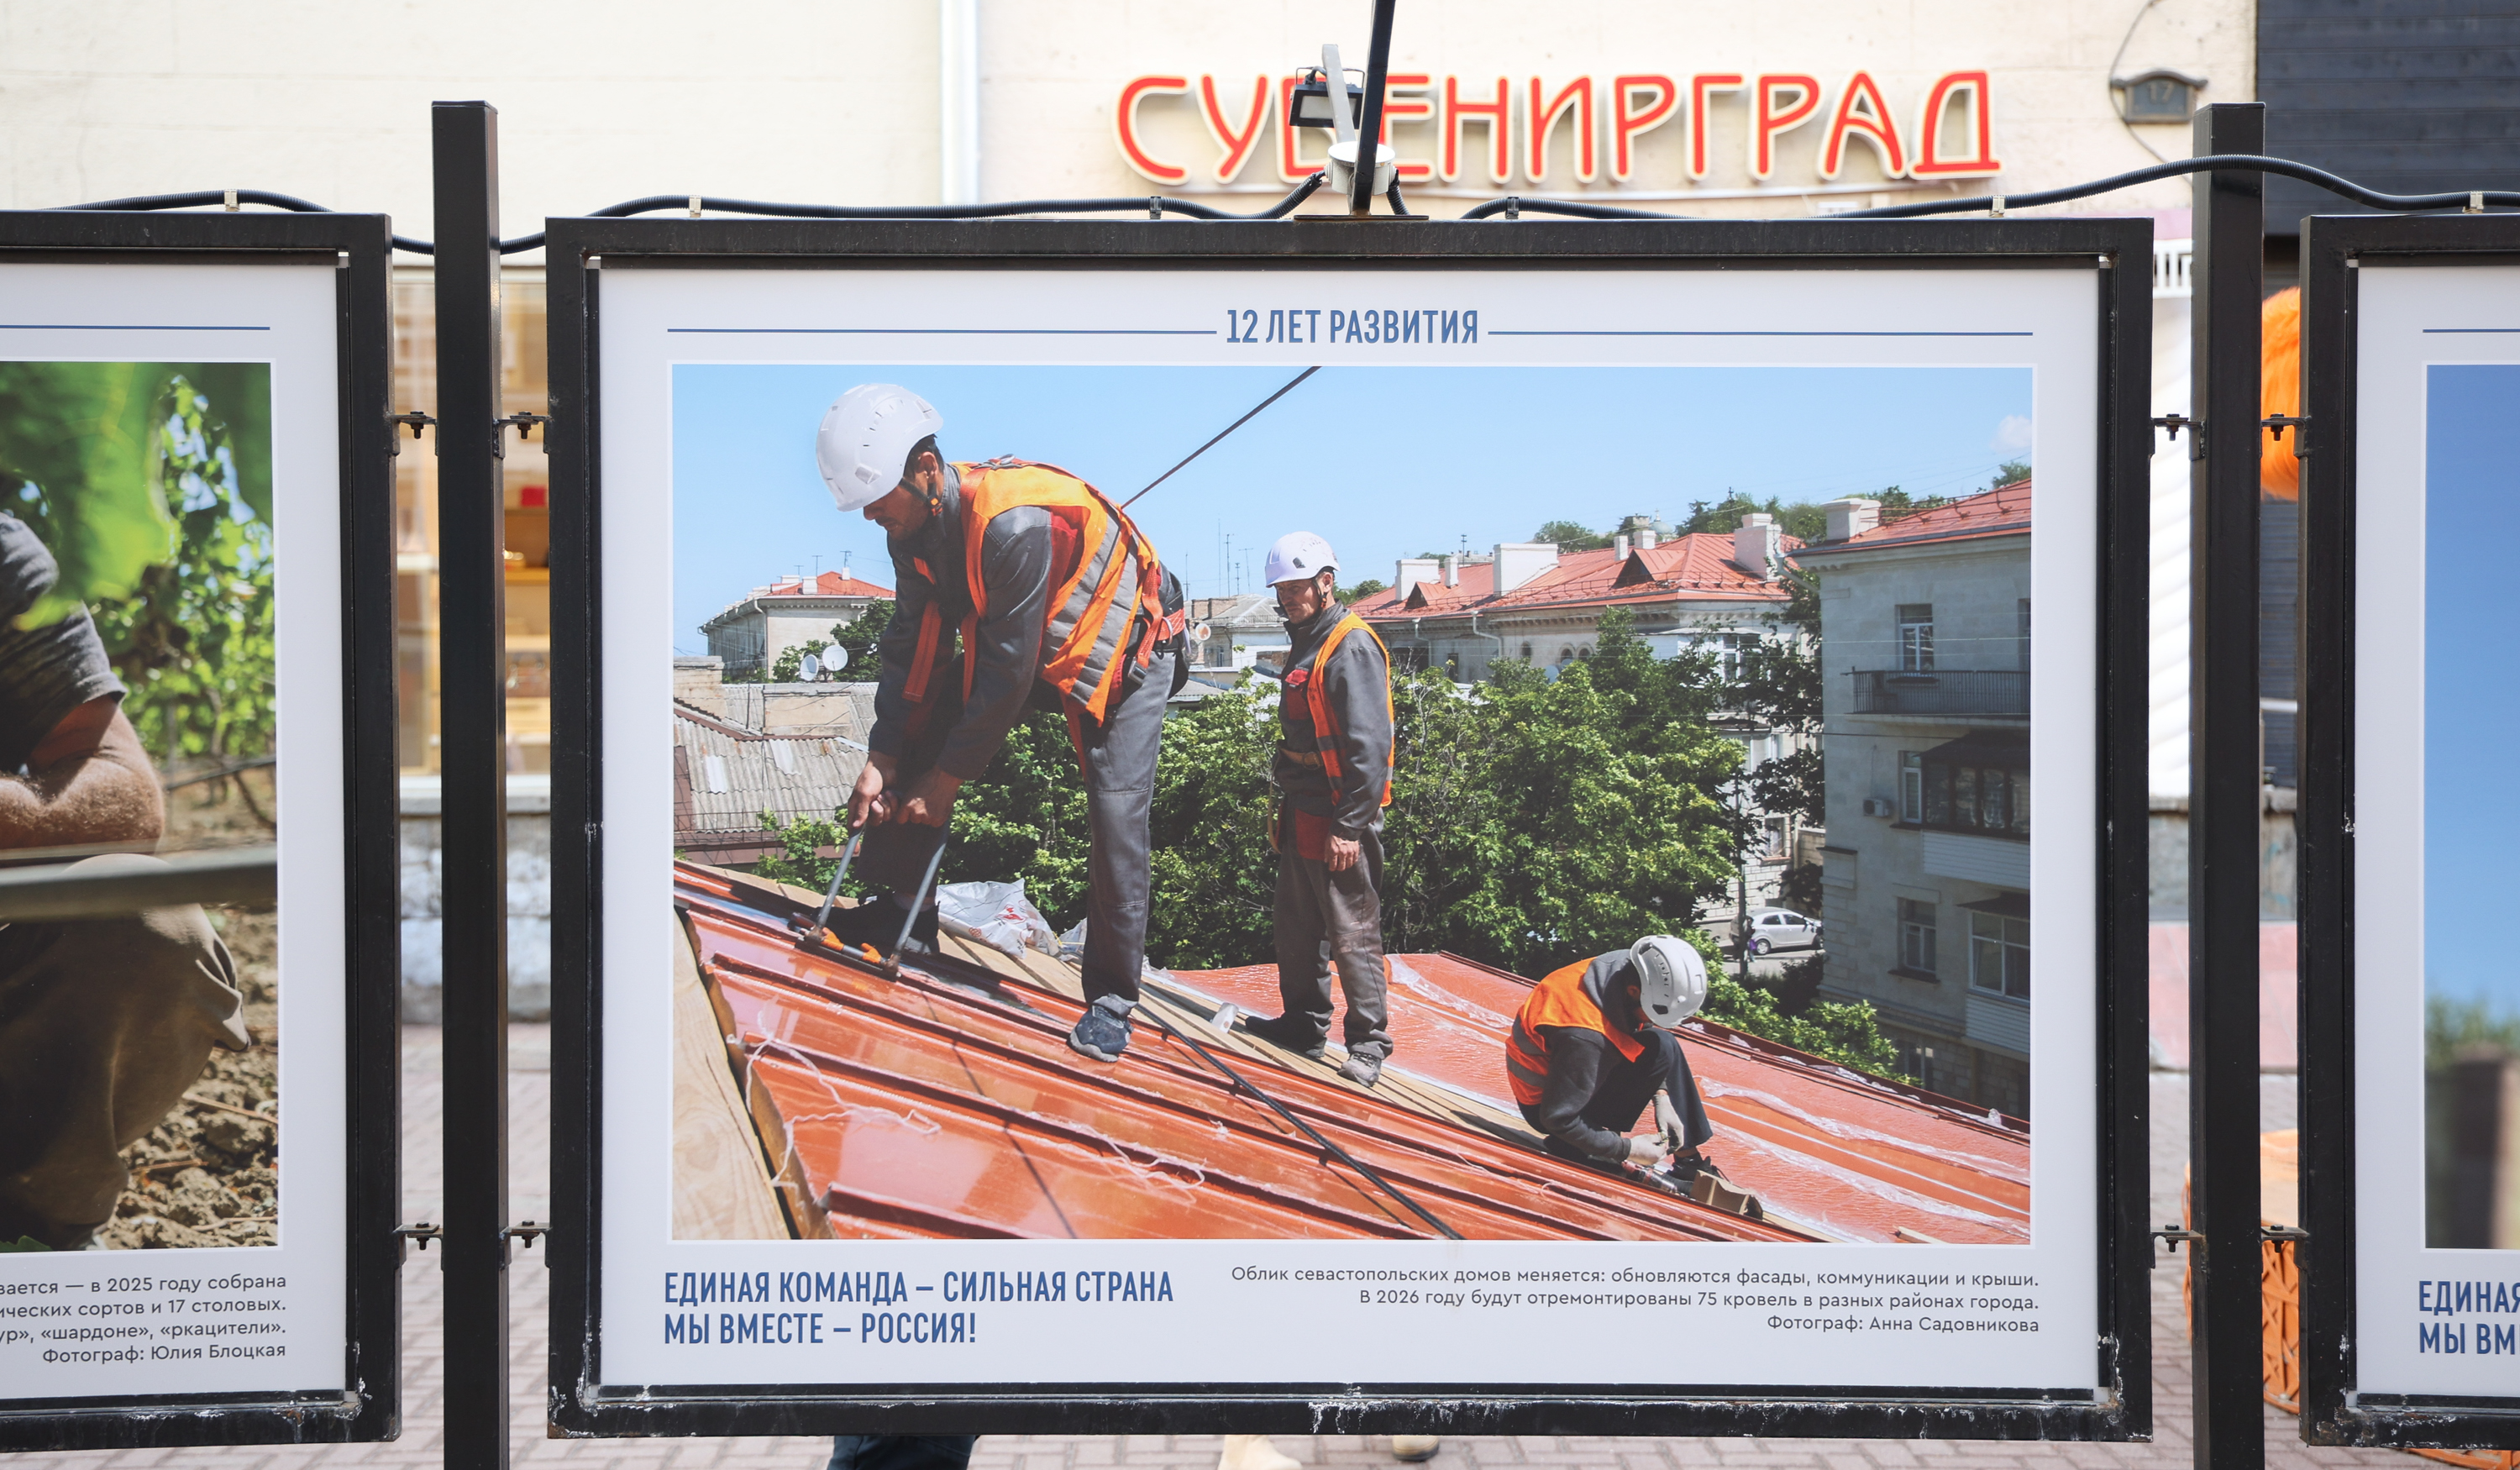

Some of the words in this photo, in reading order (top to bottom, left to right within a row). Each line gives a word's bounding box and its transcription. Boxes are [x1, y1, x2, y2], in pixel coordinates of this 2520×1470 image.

[2146, 81, 2175, 104] 17
[1226, 309, 1258, 344] 12
[1265, 309, 1321, 344] ЛЕТ
[1330, 309, 1478, 344] РАЗВИТИЯ
[91, 1281, 101, 1293] в
[107, 1277, 153, 1293] 2025
[159, 1278, 202, 1294] году
[207, 1273, 286, 1292] собрана
[664, 1271, 769, 1306] ЕДИНАЯ
[780, 1271, 909, 1306] КОМАНДА
[943, 1270, 1066, 1303] СИЛЬНАЯ
[1075, 1270, 1174, 1303] СТРАНА
[1231, 1264, 1289, 1281] Облик
[1294, 1269, 1449, 1282] севастопольских
[1453, 1269, 1511, 1284] домов
[1517, 1270, 1605, 1283] меняется:
[1611, 1267, 1730, 1284] обновляются
[1736, 1268, 1810, 1287] фасады,
[1817, 1273, 1949, 1289] коммуникации
[1956, 1273, 1966, 1286] и
[1971, 1274, 2039, 1289] крыши.
[77, 1303, 145, 1319] сортов
[151, 1303, 162, 1315] и
[168, 1299, 186, 1314] 17
[192, 1299, 286, 1313] столовых.
[1360, 1289, 1371, 1304] В
[1376, 1289, 1420, 1304] 2026
[1425, 1293, 1466, 1308] году
[1471, 1288, 1522, 1308] будут
[1527, 1293, 1692, 1309] отремонтированы
[1697, 1291, 1718, 1306] 75
[1724, 1294, 1798, 1310] кровель
[1803, 1295, 1813, 1307] в
[1819, 1295, 1884, 1310] разных
[1889, 1291, 1964, 1311] районах
[1970, 1297, 2039, 1312] города.
[40, 1326, 154, 1342] «шардоне»,
[160, 1322, 286, 1340] «ркацители».
[664, 1313, 710, 1344] МЫ
[720, 1312, 824, 1344] ВМЕСТЕ
[861, 1312, 976, 1344] РОССИЯ!
[1767, 1314, 1863, 1333] Фотограф:
[1868, 1316, 1913, 1331] Анна
[1919, 1316, 2039, 1334] Садовникова
[2419, 1322, 2466, 1354] МЫ
[2475, 1323, 2520, 1355] ВМ
[42, 1344, 144, 1365] Фотограф:
[151, 1345, 202, 1360] Юлия
[209, 1344, 286, 1360] Блоцкая
